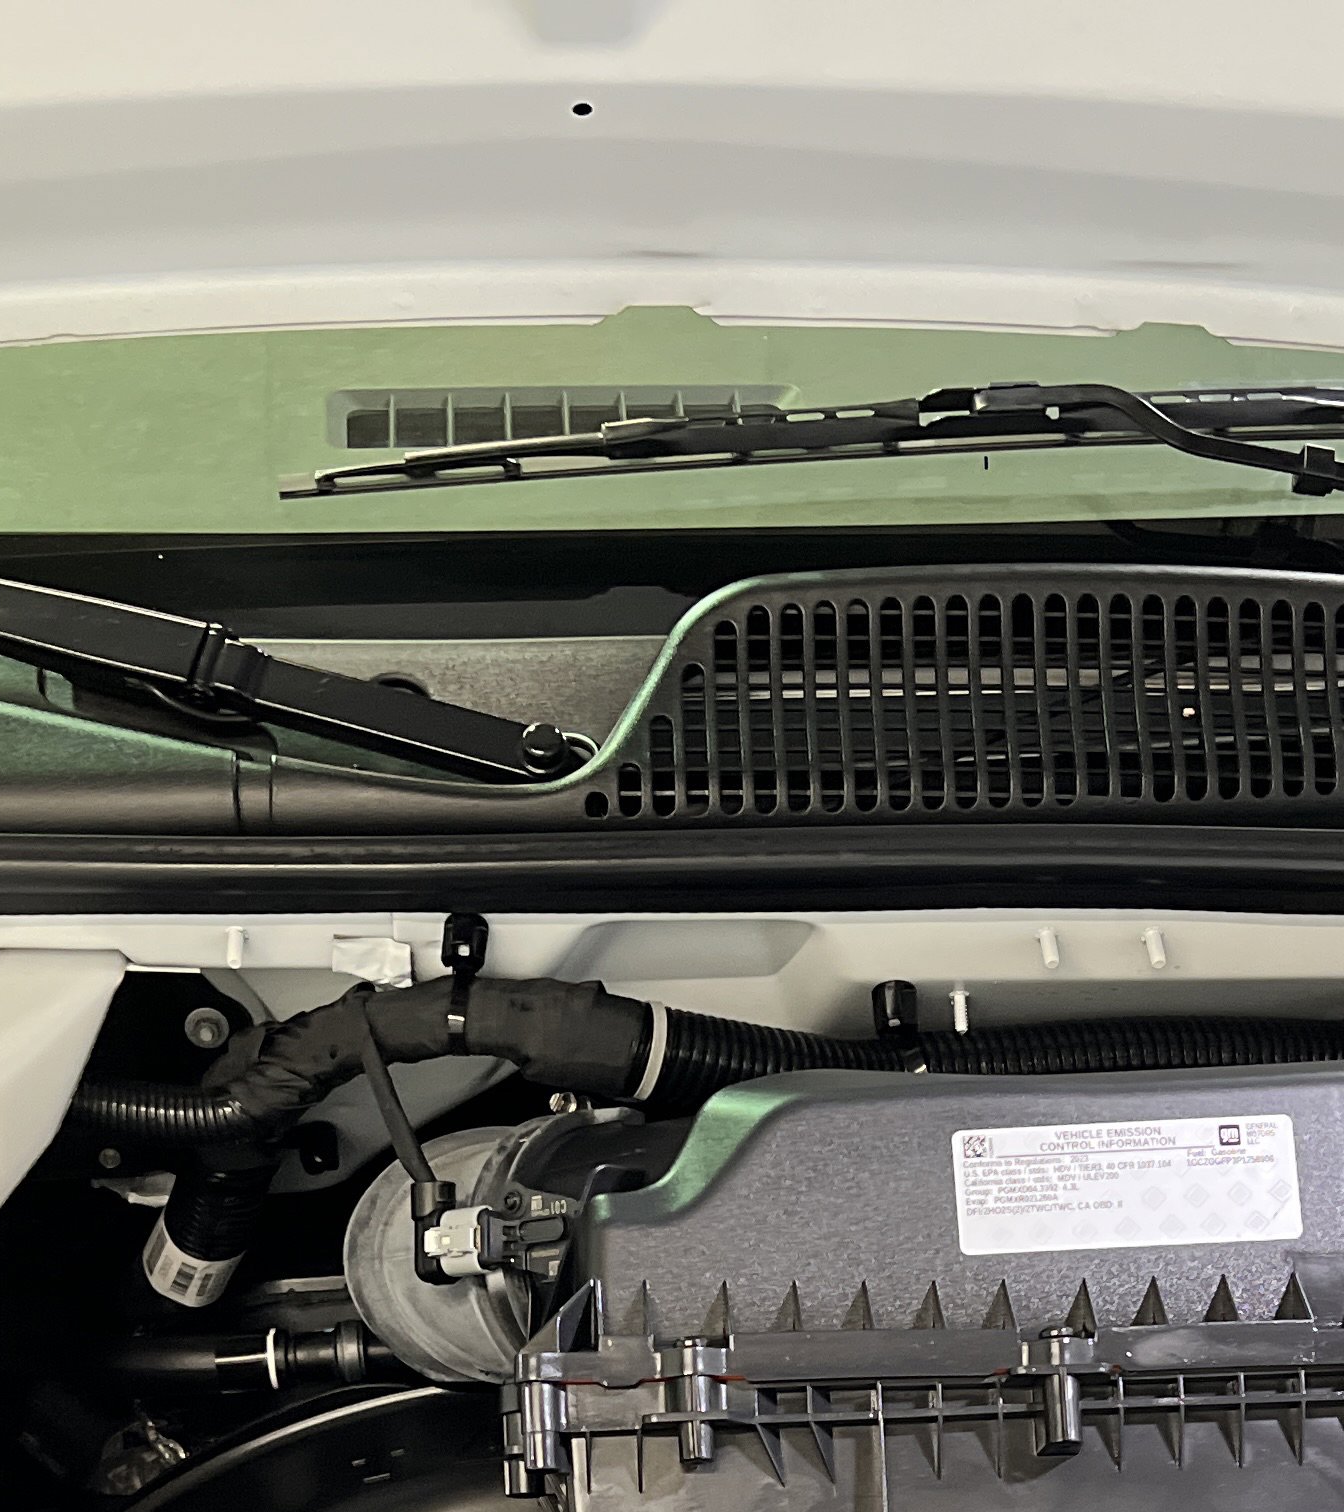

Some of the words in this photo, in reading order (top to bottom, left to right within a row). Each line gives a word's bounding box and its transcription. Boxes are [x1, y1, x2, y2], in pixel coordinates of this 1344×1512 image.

[1246, 1122, 1278, 1130] GENERAL
[1054, 1129, 1103, 1140] VEHICLE
[1106, 1127, 1162, 1138] EMISSION
[1220, 1126, 1240, 1144] gm
[1246, 1129, 1276, 1138] MOTORS
[1039, 1141, 1095, 1152] CONTROL
[1098, 1136, 1176, 1149] INFORMATION
[1186, 1148, 1206, 1157] Fuel:
[1211, 1148, 1246, 1156] Gasoline
[982, 1168, 999, 1177] EPA
